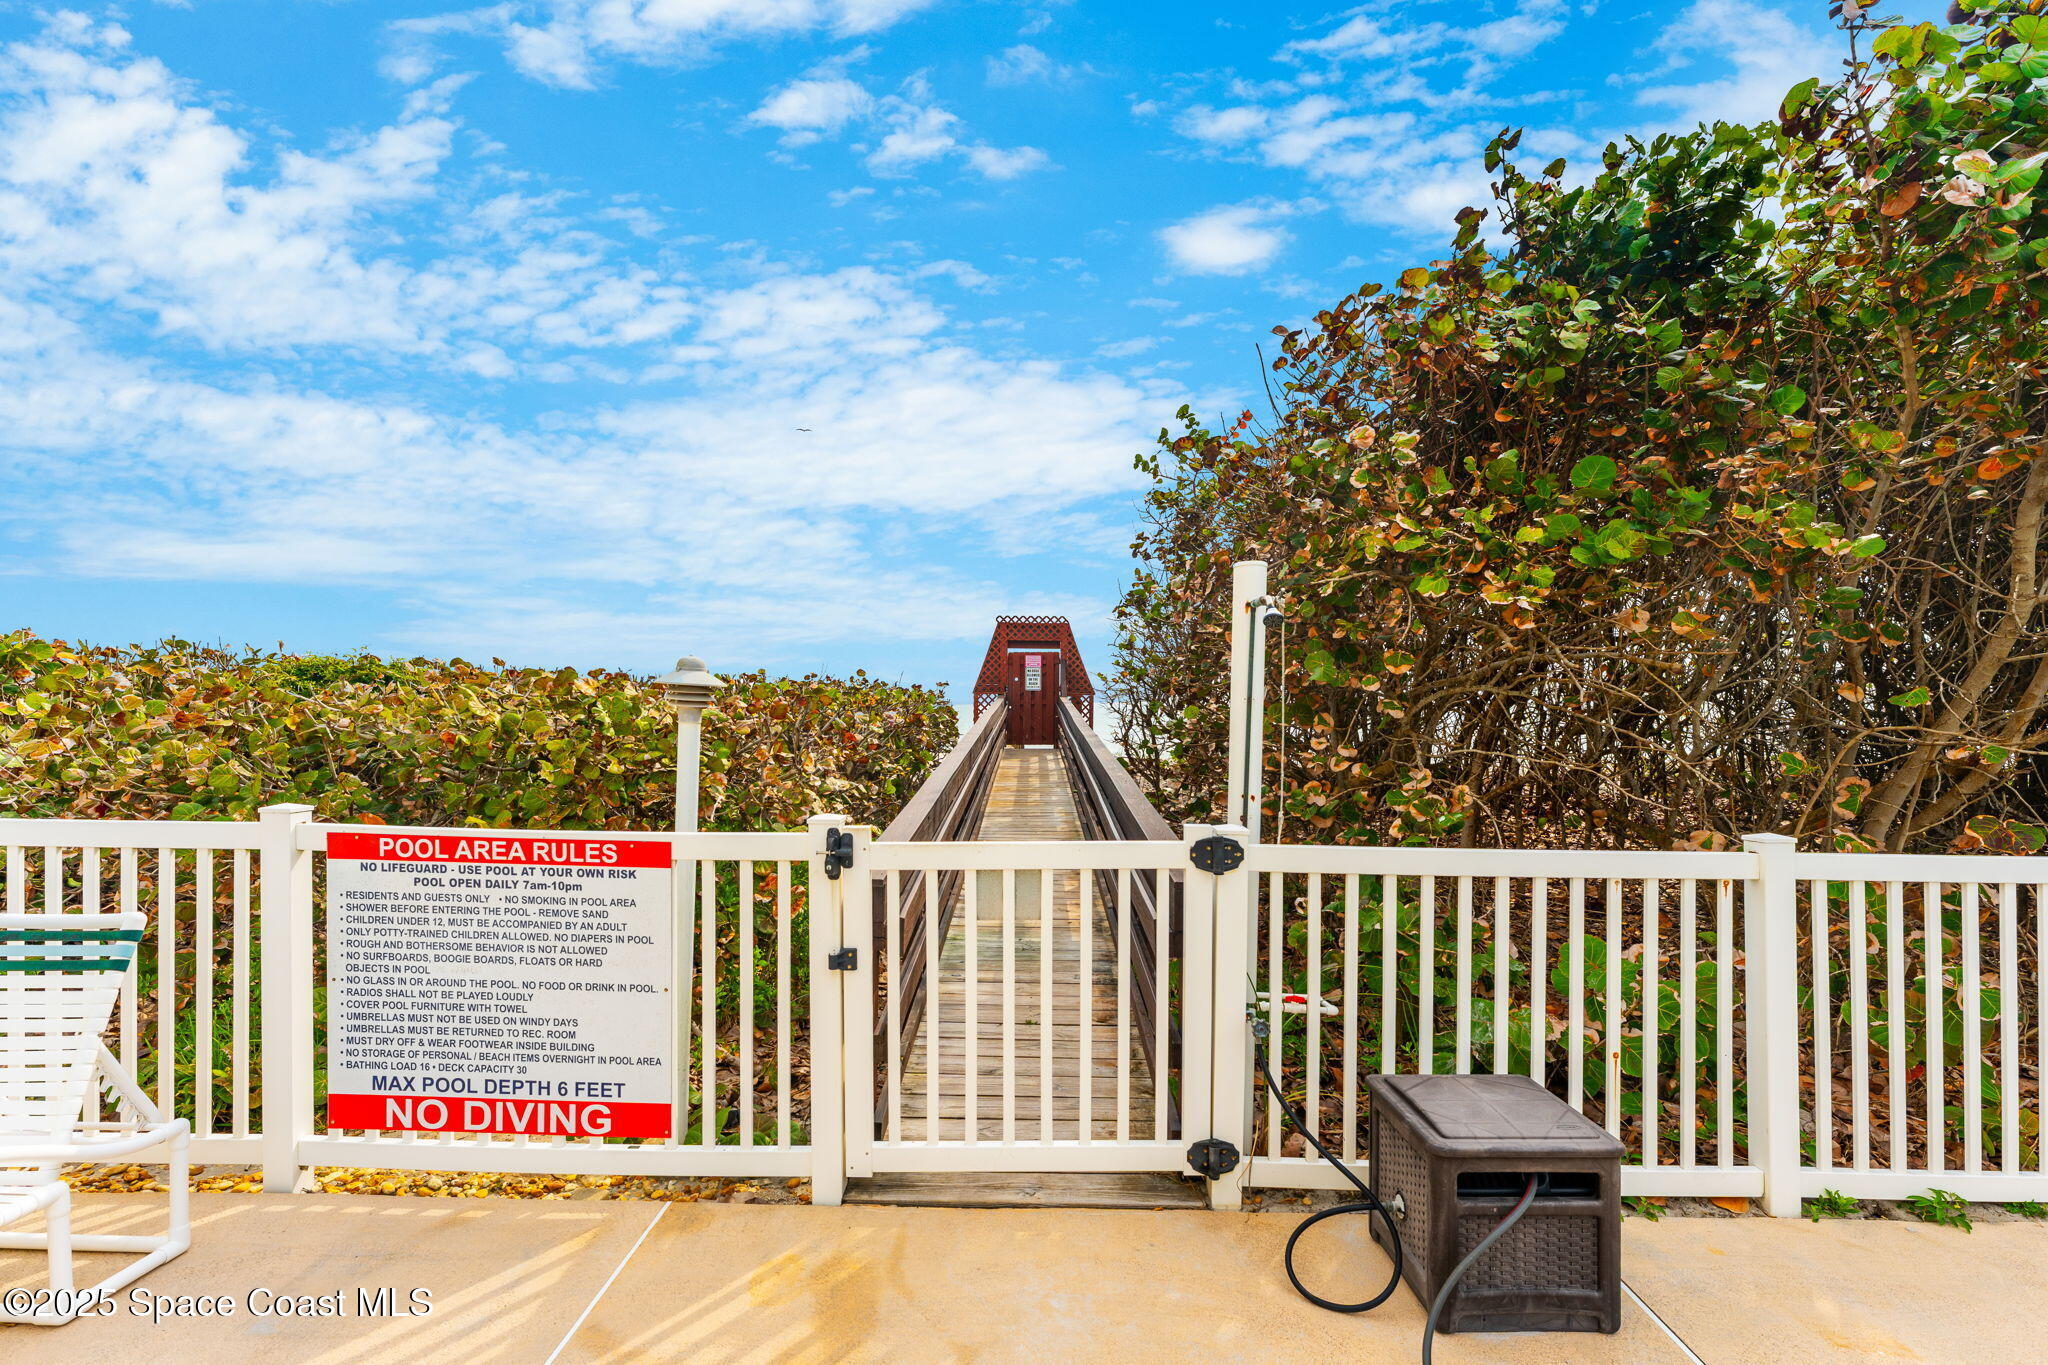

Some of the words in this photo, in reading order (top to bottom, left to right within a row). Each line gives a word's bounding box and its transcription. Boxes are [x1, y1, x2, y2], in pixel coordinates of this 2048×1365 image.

[379, 837, 449, 858] POOL
[454, 839, 526, 860] AREA
[533, 841, 617, 863] RULES
[360, 862, 377, 871] NO
[381, 862, 447, 873] LIFEGUARD
[458, 864, 481, 874] USE
[485, 865, 517, 875] POOL
[520, 866, 536, 876] AT
[539, 867, 572, 877] YOUR
[576, 868, 604, 878] OWN
[608, 869, 636, 879] RISK
[413, 877, 445, 887] POOL
[448, 877, 481, 888] OPEN
[485, 879, 519, 889] DAILY
[522, 880, 582, 893] 7am-10pm
[345, 890, 399, 900] RESIDENTS
[401, 892, 421, 901] AND
[423, 892, 462, 902] GUESTS
[464, 894, 489, 903] ONLY
[504, 895, 518, 904] NO
[521, 895, 566, 905] SMOKING
[568, 897, 578, 905] IN
[580, 897, 607, 906] POOL
[609, 898, 636, 907] AREA
[345, 902, 388, 912] SHOWER
[390, 904, 429, 913] BEFORE
[431, 905, 480, 915] ENTERING
[482, 906, 501, 915] THE
[503, 907, 530, 916] POOL
[538, 908, 579, 918] REMOVE
[581, 909, 608, 918] SAND
[345, 914, 394, 924] CHILDREN
[396, 916, 429, 925] UNDER
[432, 917, 445, 926] 12,
[447, 917, 474, 927] MUST
[477, 918, 489, 927] BE
[491, 919, 562, 929] ACCOMPANIED
[564, 921, 578, 929] BY
[579, 921, 593, 930] AN
[595, 922, 627, 931] ADULT
[345, 927, 371, 936] ONLY
[373, 927, 448, 938] POTTY-TRAINED
[451, 930, 499, 939] CHILDREN
[501, 931, 551, 941] ALLOWED.
[554, 933, 568, 942] NO
[570, 933, 612, 943] DIAPERS
[615, 935, 624, 943] IN
[627, 935, 654, 944] POOL
[346, 939, 380, 948] ROUGH
[382, 940, 403, 949] AND
[405, 940, 472, 951] BOTHERSOME
[475, 942, 524, 952] BEHAVIOR
[526, 944, 535, 953] IS
[538, 945, 557, 953] NOT
[559, 945, 607, 955] ALLOWED
[346, 951, 360, 960] NO
[362, 951, 431, 962] SURFBOARDS,
[433, 953, 470, 963] BOOGIE
[473, 955, 516, 965] BOARDS,
[519, 956, 556, 966] FLOATS
[558, 957, 572, 966] OR
[575, 958, 602, 967] HARD
[345, 963, 389, 973] OBJECTS
[392, 964, 401, 973] IN
[404, 965, 430, 974] POOL
[346, 975, 360, 984] NO
[362, 975, 395, 985] GLASS
[397, 977, 406, 985] IN
[409, 977, 423, 986] OR
[425, 978, 466, 987] AROUND
[469, 979, 487, 988] THE
[490, 979, 519, 989] POOL.
[522, 980, 536, 989] NO
[538, 981, 566, 990] FOOD
[568, 982, 582, 991] OR
[585, 982, 614, 991] DRINK
[617, 983, 626, 992] IN
[346, 987, 382, 997] RADIOS
[385, 988, 416, 998] SHALL
[418, 989, 438, 998] NOT
[441, 990, 453, 999] BE
[456, 990, 493, 1000] PLAYED
[496, 992, 533, 1001] LOUDLY
[346, 999, 379, 1009] COVER
[382, 1000, 408, 1009] POOL
[411, 1001, 464, 1011] FURNITURE
[467, 1003, 491, 1012] WITH
[493, 1004, 527, 1013] TOWEL
[346, 1011, 405, 1022] UMBRELLAS
[407, 1013, 434, 1022] MUST
[436, 1014, 456, 1023] NOT
[458, 1015, 471, 1024] BE
[474, 1015, 500, 1024] USED
[502, 1016, 516, 1025] ON
[519, 1017, 550, 1026] WINDY
[553, 1018, 578, 1027] DAYS
[346, 1023, 405, 1034] UMBRELLAS
[407, 1025, 434, 1034] MUST
[436, 1026, 449, 1035] BE
[452, 1027, 504, 1037] RETURNED
[506, 1028, 519, 1037] TO
[522, 1029, 544, 1038] REC.
[546, 1030, 576, 1039] ROOM
[346, 1036, 373, 1045] MUST
[375, 1036, 394, 1045] DRY
[396, 1037, 415, 1046] OFF
[418, 1038, 425, 1046] &
[427, 1038, 456, 1047] WEAR
[458, 1039, 513, 1049] FOOTWEAR
[515, 1041, 546, 1050] INSIDE
[549, 1042, 594, 1052] BUILDING
[345, 1048, 359, 1057] NO
[361, 1048, 405, 1058] STORAGE
[407, 1049, 420, 1058] OF
[422, 1050, 472, 1060] PERSONAL
[478, 1052, 510, 1061] BEACH
[512, 1053, 540, 1062] ITEMS
[542, 1054, 595, 1064] OVERNIGHT
[597, 1056, 606, 1064] IN
[609, 1056, 634, 1065] POOL
[636, 1056, 661, 1066] AREA
[346, 1060, 388, 1069] BATHING
[390, 1061, 417, 1070] LOAD
[419, 1062, 430, 1071] 16
[438, 1062, 464, 1072] DECK
[467, 1063, 514, 1073] CAPACITY
[516, 1065, 527, 1074] 30
[371, 1075, 416, 1091] MAX
[422, 1076, 478, 1093] POOL
[484, 1078, 550, 1096] DEPTH
[557, 1081, 568, 1096] 6
[575, 1081, 626, 1098] FEET
[386, 1098, 448, 1129] NO
[464, 1100, 611, 1134] DIVING
